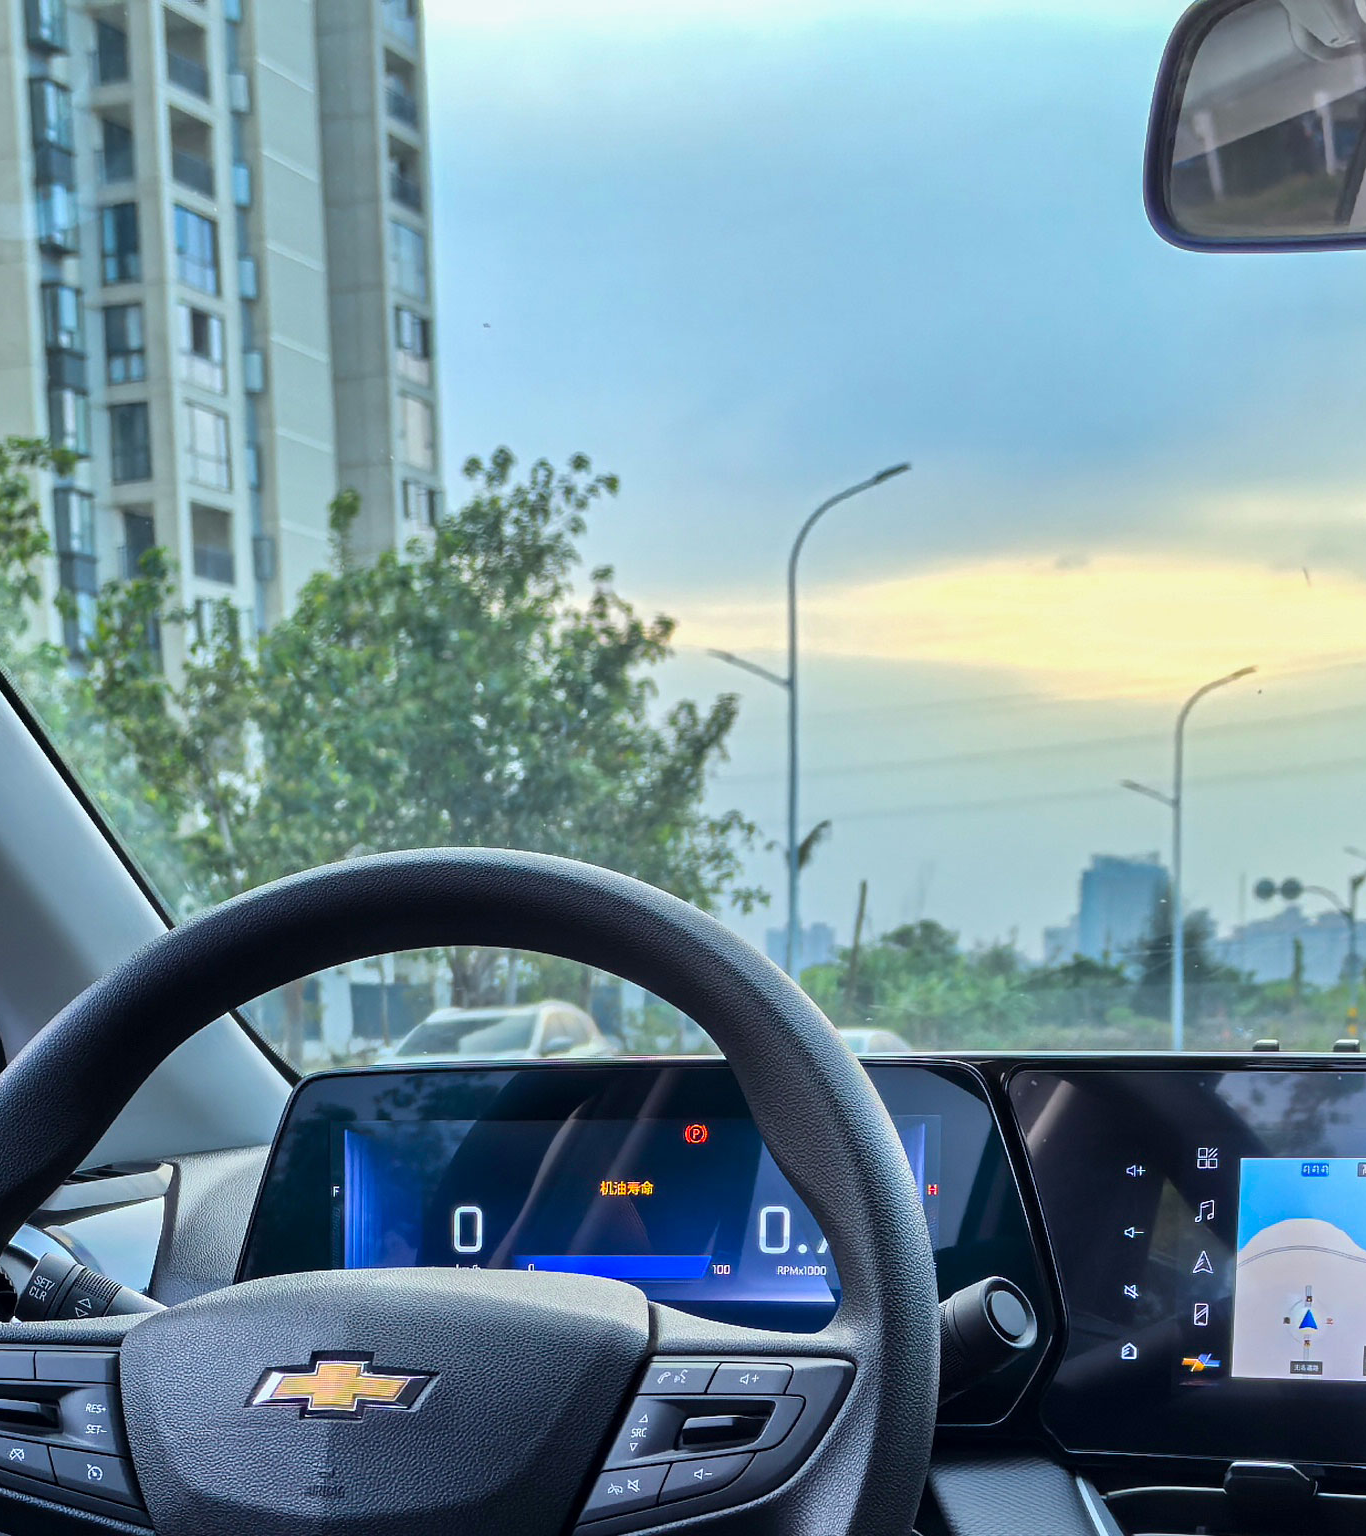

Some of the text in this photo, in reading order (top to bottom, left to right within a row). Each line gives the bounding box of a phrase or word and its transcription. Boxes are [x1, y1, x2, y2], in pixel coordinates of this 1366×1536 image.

[332, 1186, 340, 1197] F
[600, 1180, 654, 1196] 机油寿命
[927, 1184, 938, 1196] H
[453, 1206, 483, 1253] 0
[712, 1264, 731, 1275] 100
[777, 1265, 827, 1276] RPMx1000
[34, 1275, 55, 1291] SET/
[28, 1286, 47, 1302] CLR
[85, 1402, 107, 1414] RES+
[630, 1427, 647, 1438] SRC
